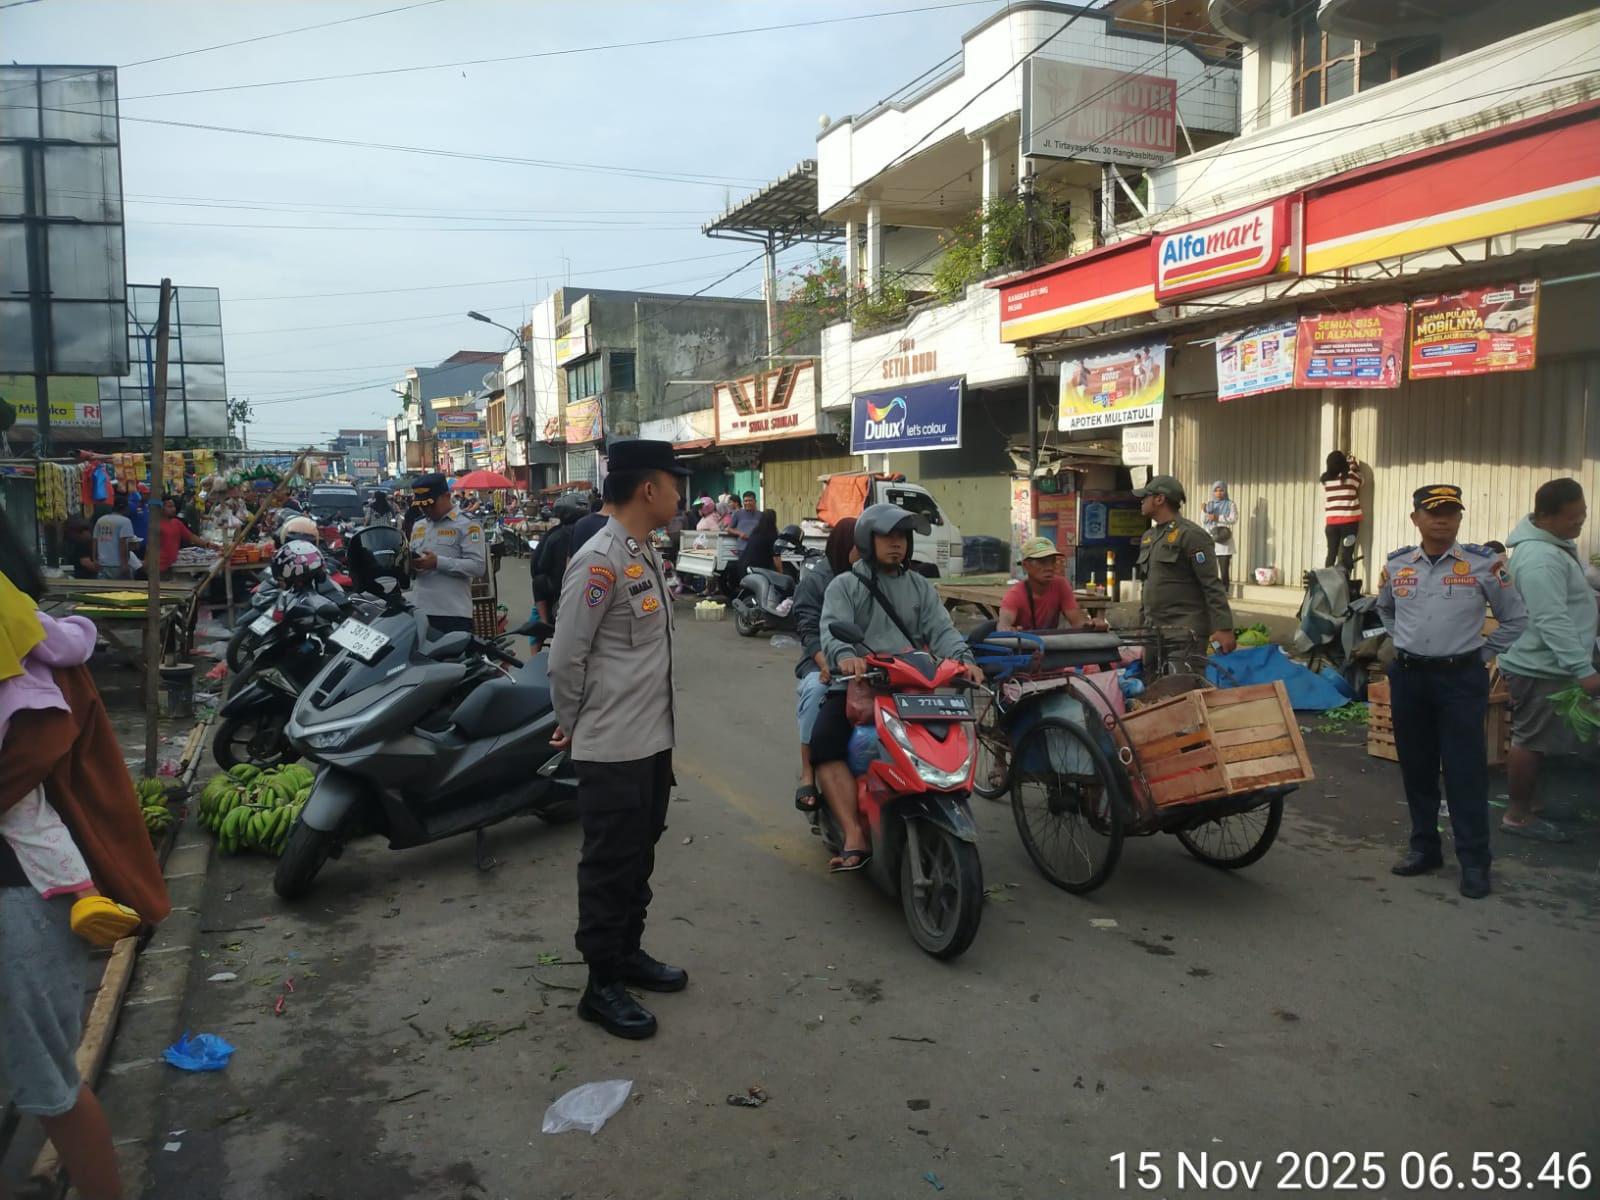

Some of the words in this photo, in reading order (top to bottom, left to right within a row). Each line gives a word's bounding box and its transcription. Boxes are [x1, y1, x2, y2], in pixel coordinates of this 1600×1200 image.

[1163, 216, 1263, 266] Alfamart
[1318, 320, 1352, 331] SEMUA
[1355, 317, 1380, 329] BISA
[1417, 317, 1483, 336] MOBILNYA
[1314, 331, 1325, 340] DI
[1327, 328, 1384, 340] ALFAMART
[882, 355, 910, 379] SETIA
[912, 350, 937, 375] BUDI
[1070, 416, 1102, 428] APOTEK
[1104, 407, 1154, 424] MULTATULI
[865, 420, 901, 439] Dulux
[906, 424, 921, 436] let's
[922, 422, 947, 435] colour
